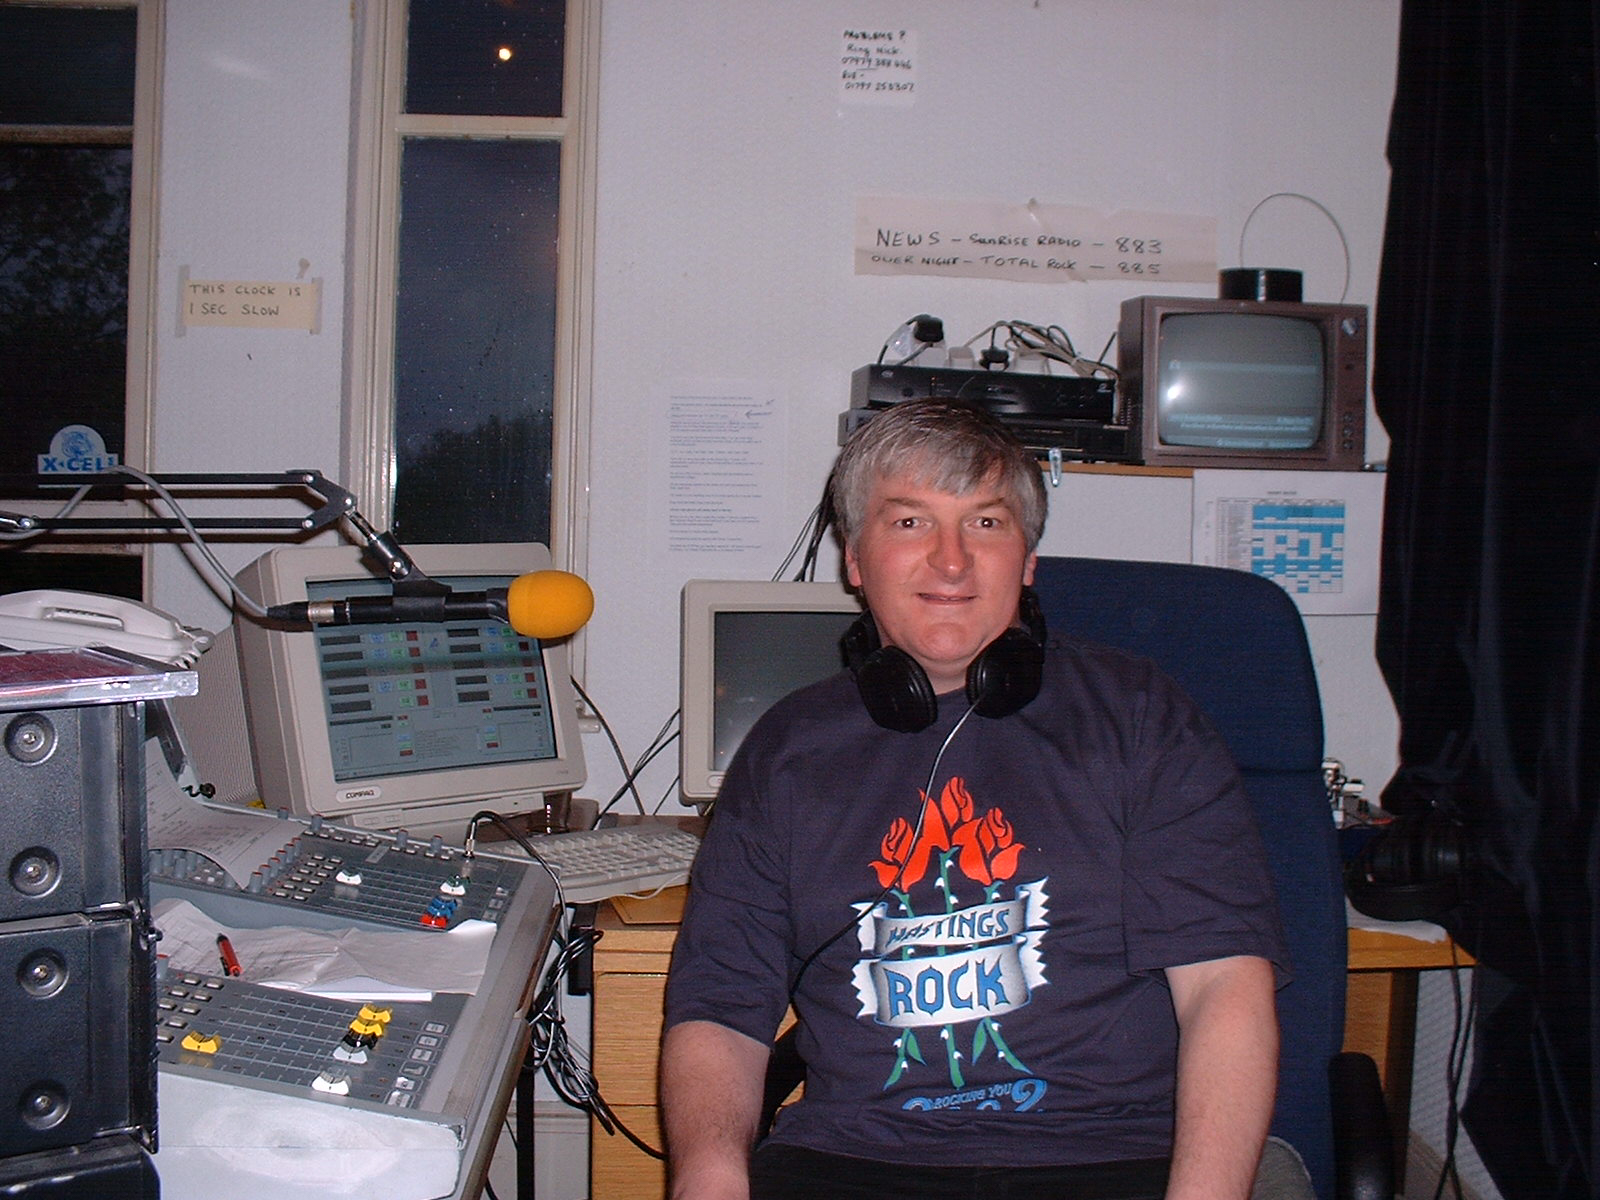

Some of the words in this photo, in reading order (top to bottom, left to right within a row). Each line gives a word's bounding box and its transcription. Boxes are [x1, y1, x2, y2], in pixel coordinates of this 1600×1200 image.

[876, 228, 940, 247] NEWS
[1037, 235, 1081, 248] RADIO
[1115, 236, 1162, 254] 883
[921, 256, 959, 266] NIGHT
[980, 255, 1039, 269] TOTAL
[1117, 261, 1162, 275] 885
[189, 283, 225, 295] THIS
[235, 285, 276, 295] CLOCK
[288, 286, 301, 297] IS
[200, 302, 227, 315] SEC
[241, 304, 279, 316] SLOW
[345, 789, 375, 799] COMPAQ
[885, 909, 1010, 947] HASTINGS
[883, 953, 1011, 1020] ROCK
[988, 1083, 1013, 1098] YOU
